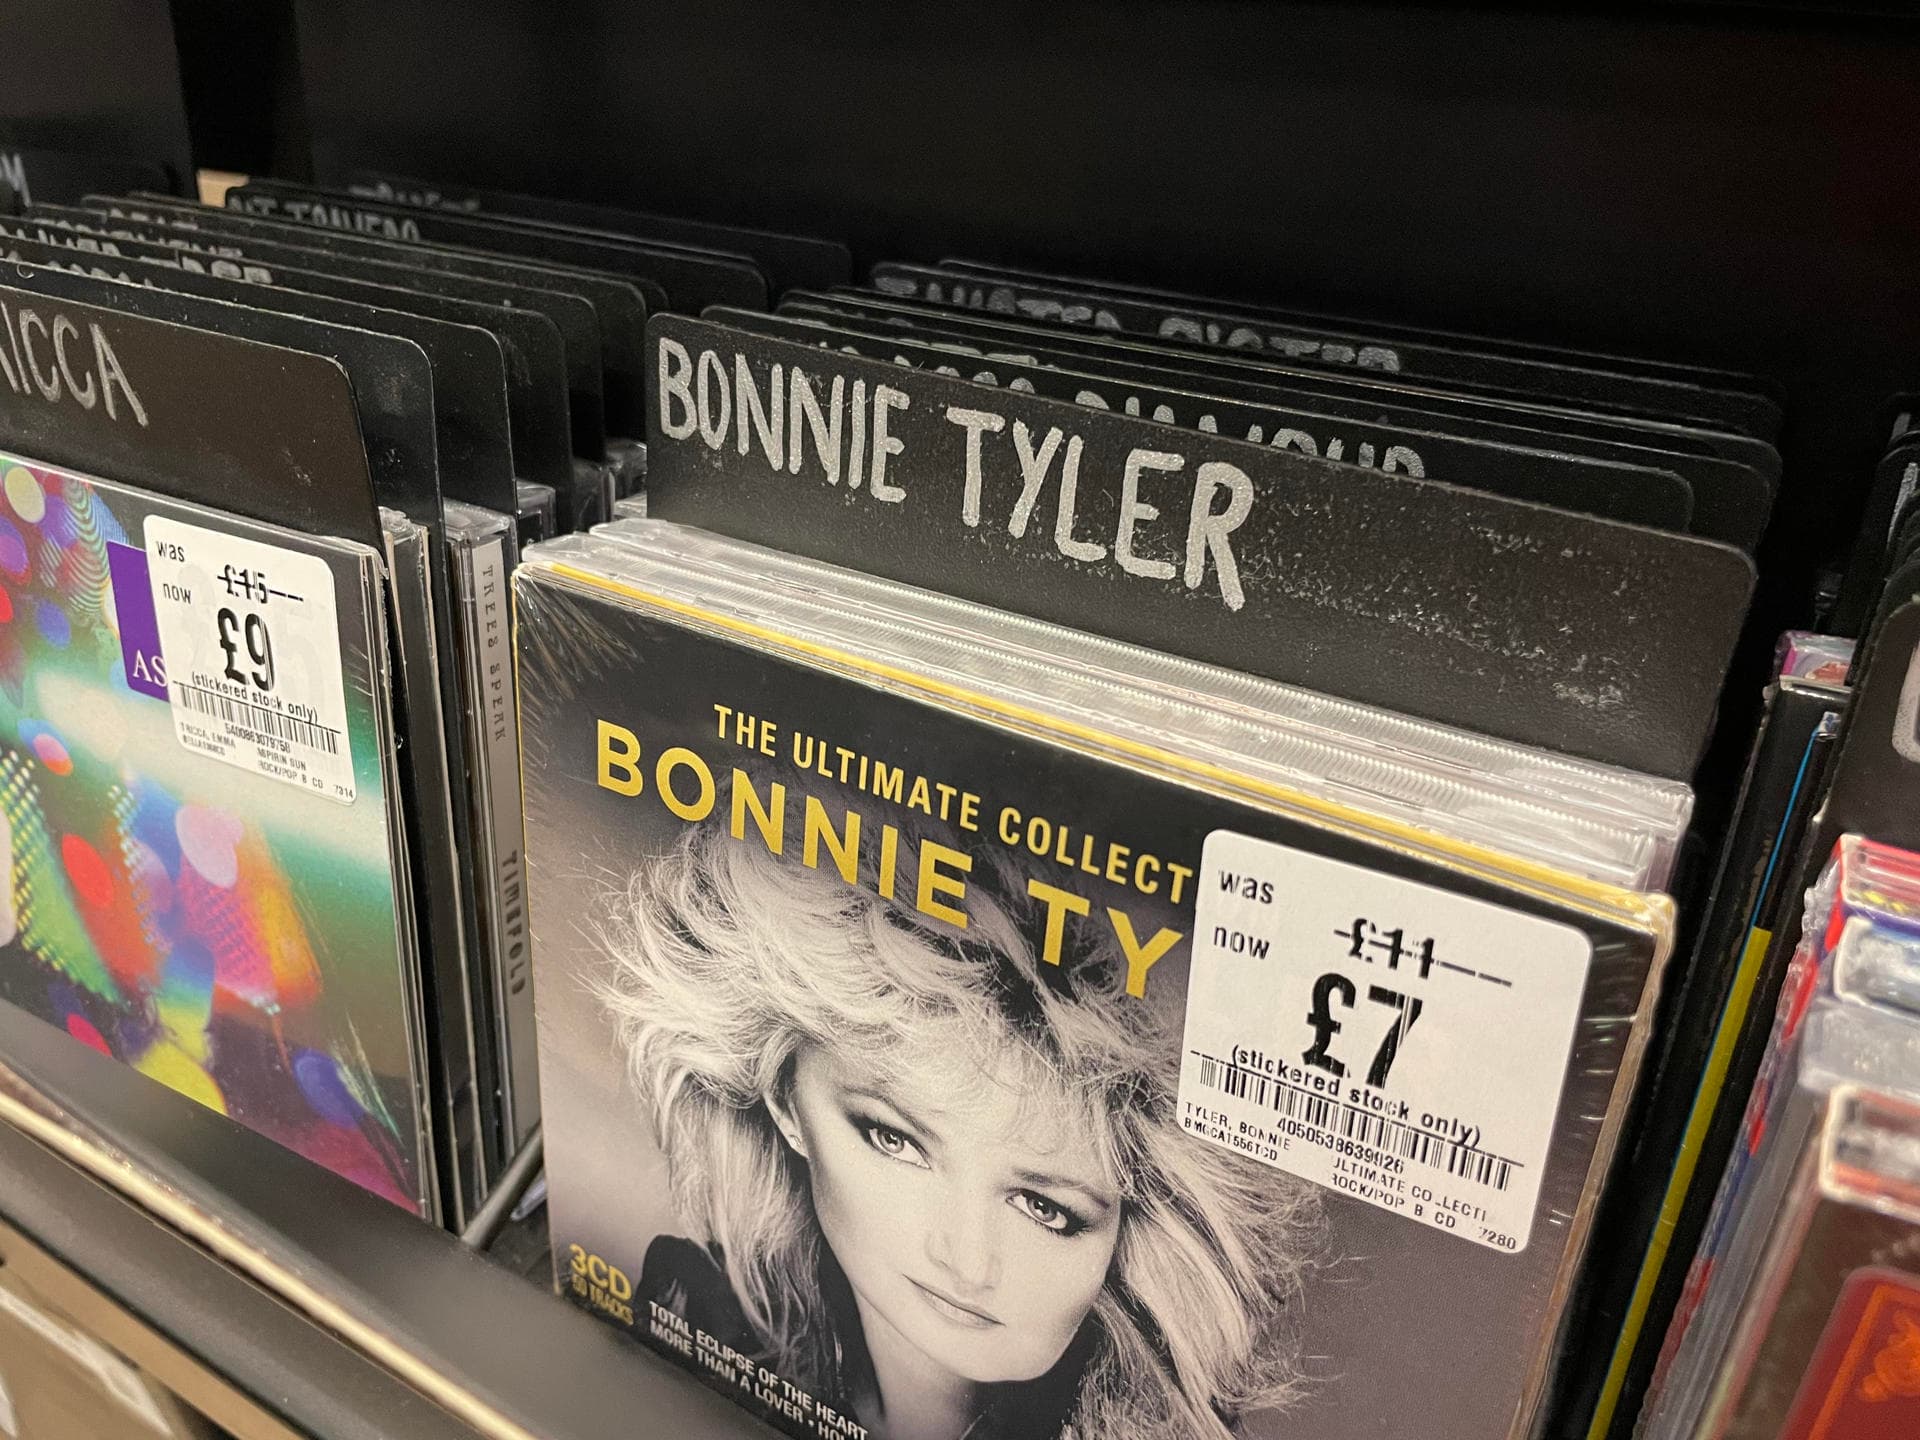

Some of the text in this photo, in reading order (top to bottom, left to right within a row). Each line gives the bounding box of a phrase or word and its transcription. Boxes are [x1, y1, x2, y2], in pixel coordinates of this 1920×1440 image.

[657, 337, 910, 503] BONNIE
[946, 405, 1254, 611] TYLER
[156, 541, 185, 562] was
[163, 583, 191, 604] now
[481, 565, 499, 648] TREES
[133, 650, 168, 688] AS
[217, 607, 276, 692] £9
[192, 672, 318, 724] (stickered stock only)
[713, 703, 1193, 904] THE ULTIMATE COLLECT
[596, 718, 1185, 1000] BONNIE TY
[1218, 870, 1275, 904] was
[1213, 925, 1271, 960] now
[1301, 972, 1424, 1090] £7
[1185, 1101, 1292, 1150] TYLER, BONNIE
[1231, 1044, 1481, 1149] (stickered stock only)
[1276, 1116, 1405, 1175] 4050538639926
[1413, 1203, 1424, 1217] B
[1433, 1212, 1457, 1229] CD
[568, 1243, 633, 1302] 3CD
[650, 1300, 869, 1440] TOTAL ECLIPSE OF THE HEART
[650, 1321, 693, 1359] MORE
[695, 1346, 735, 1383] THAN
[739, 1374, 751, 1392] A
[754, 1382, 804, 1423] LOVER
